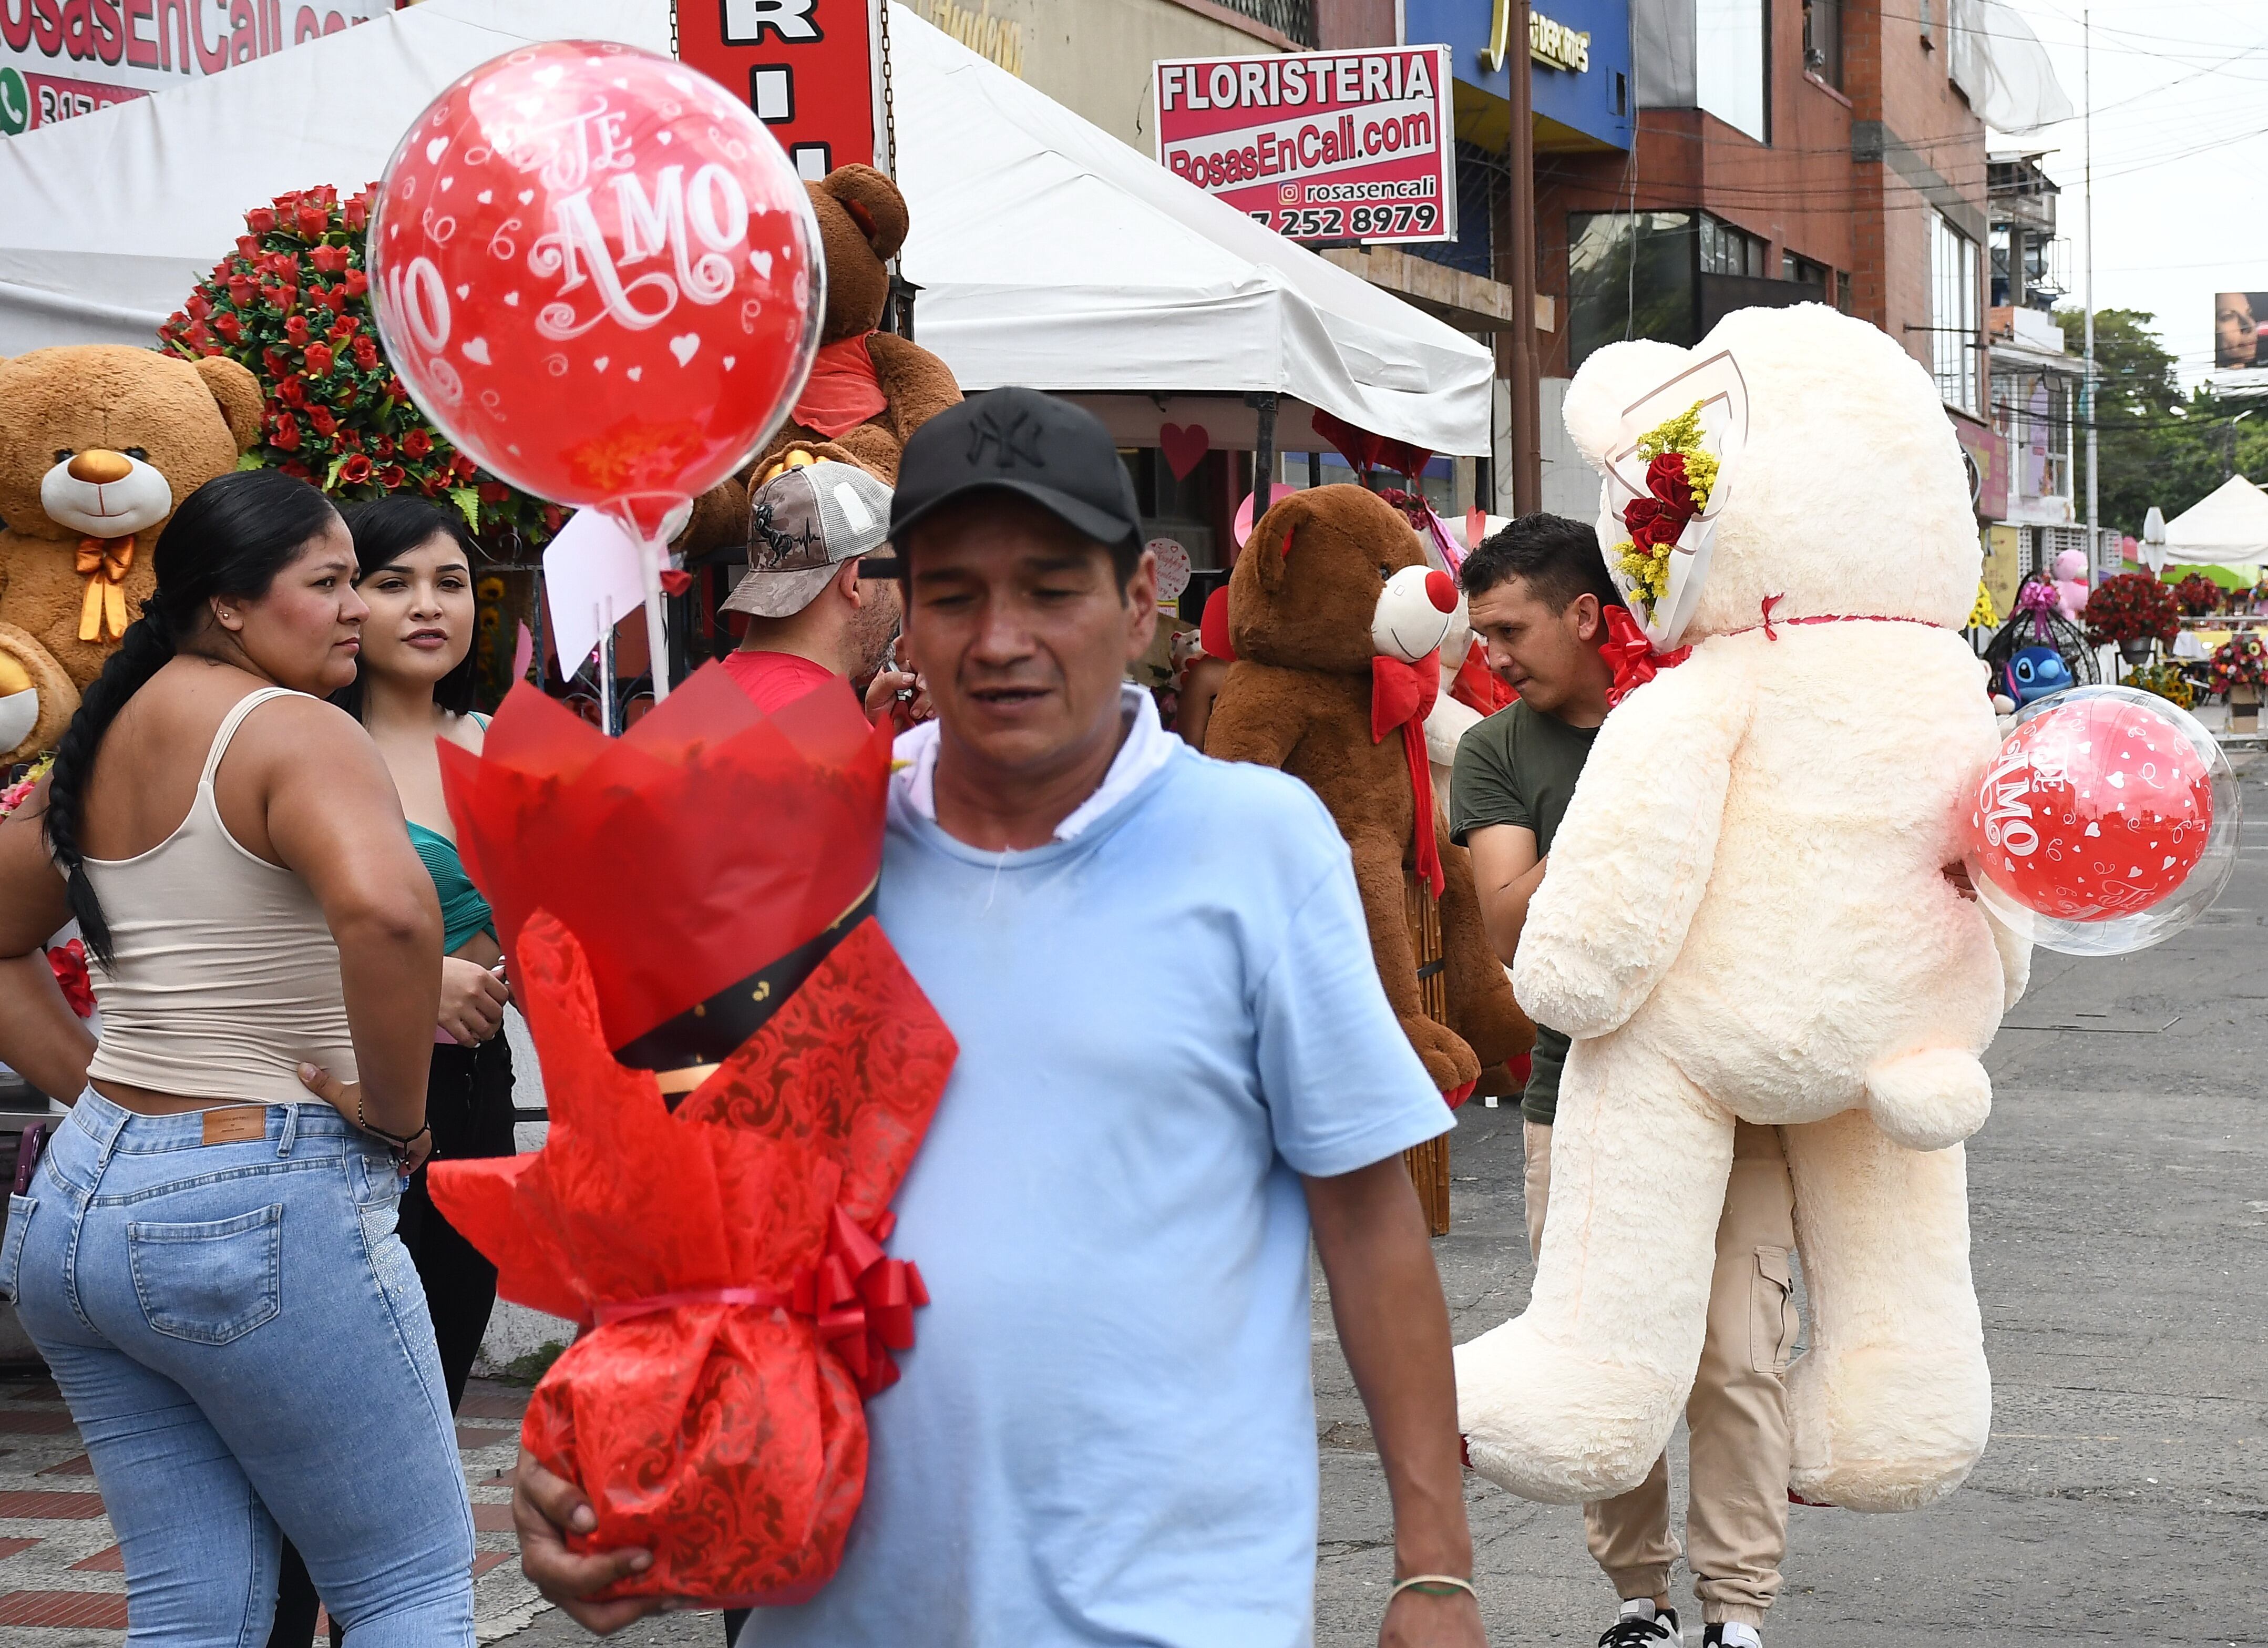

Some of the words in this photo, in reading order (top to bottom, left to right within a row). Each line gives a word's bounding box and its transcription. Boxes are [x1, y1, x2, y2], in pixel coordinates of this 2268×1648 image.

[1162, 54, 1434, 110] FLORISTERIA
[511, 96, 636, 192] TE
[1169, 111, 1432, 189] RosasEnCali.com
[1280, 209, 1342, 236] 252
[1352, 204, 1436, 233] 8979
[1306, 176, 1435, 201] rosasencali
[528, 162, 748, 341] AMO
[966, 410, 1045, 468] NY
[1980, 740, 2039, 856] AMO
